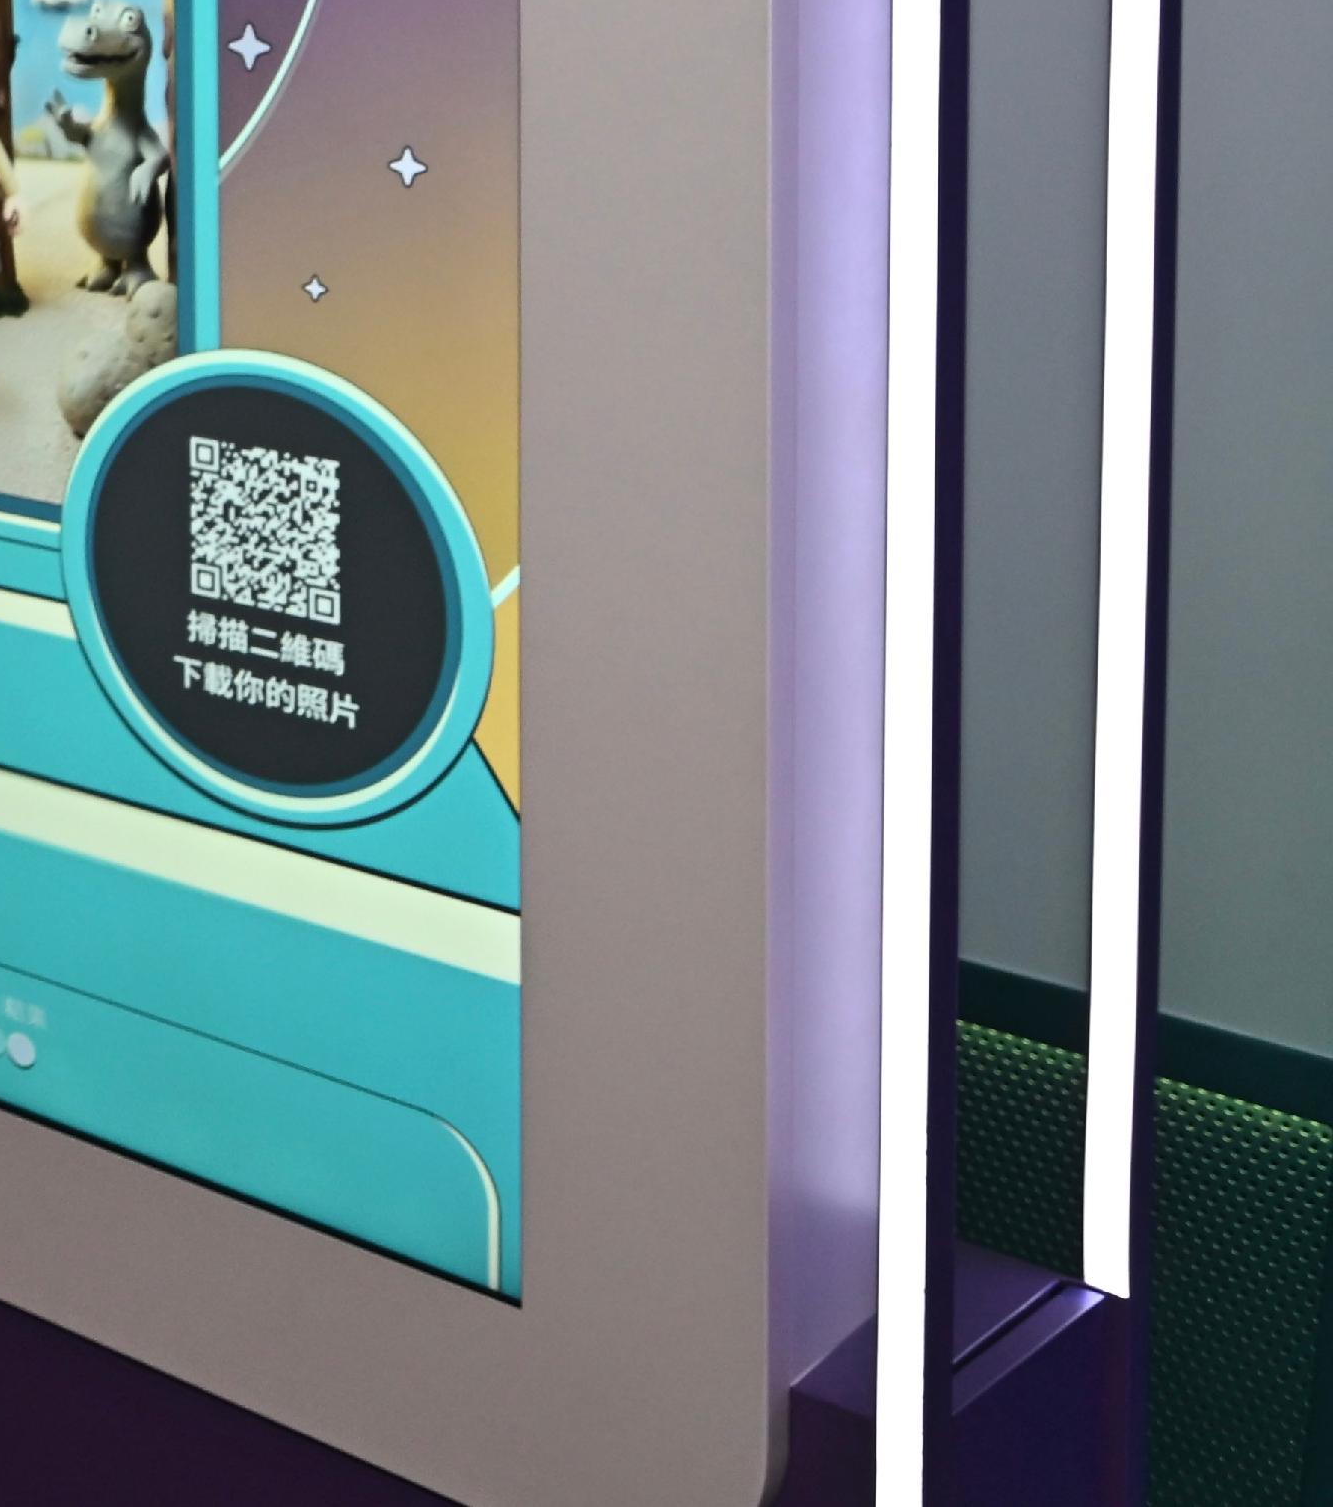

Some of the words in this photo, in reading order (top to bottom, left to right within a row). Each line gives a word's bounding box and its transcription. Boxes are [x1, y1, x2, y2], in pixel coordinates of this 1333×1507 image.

[186, 608, 346, 676] 掃描二維碼
[173, 654, 360, 730] 下載你的照片
